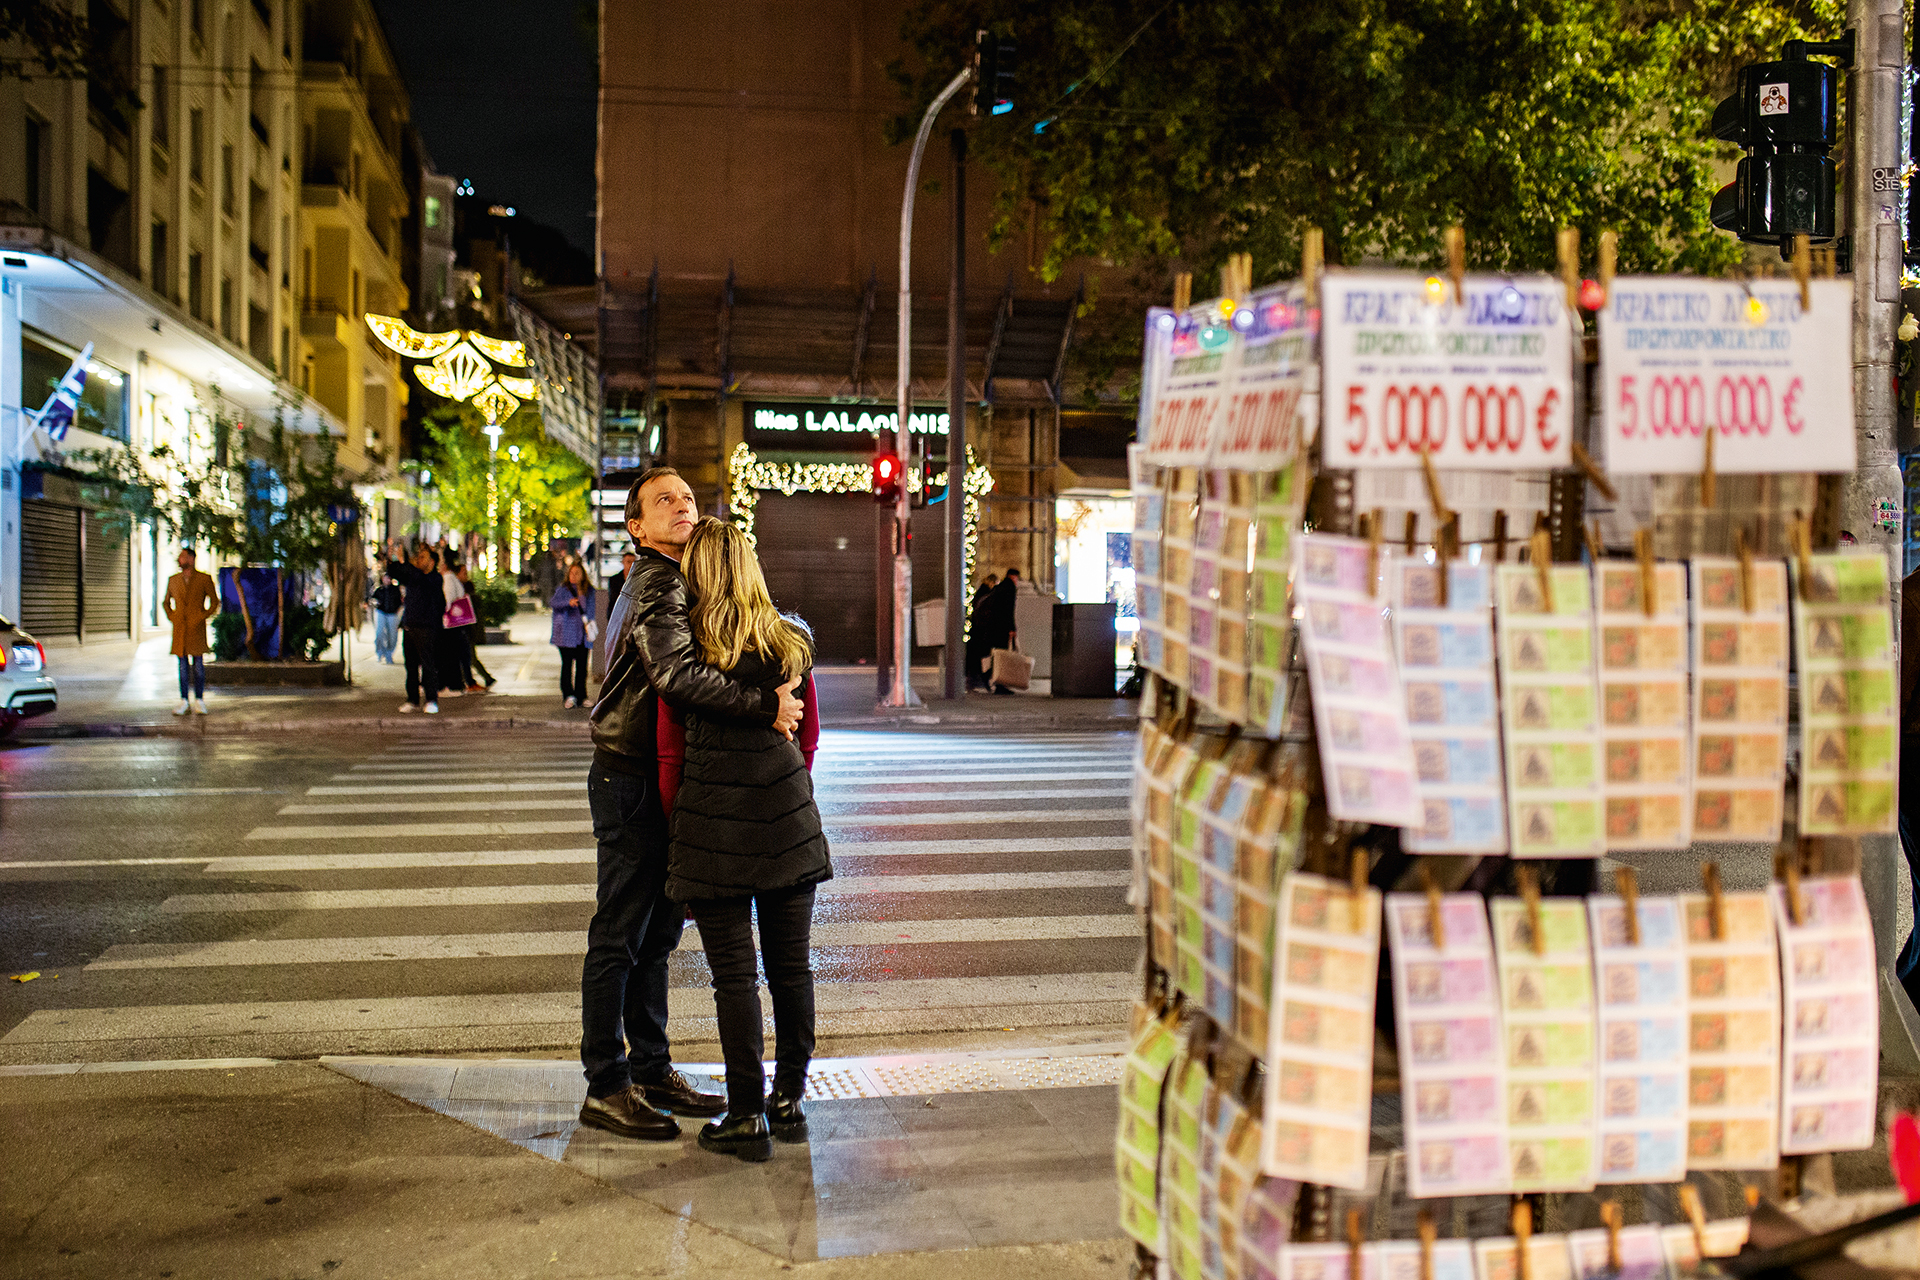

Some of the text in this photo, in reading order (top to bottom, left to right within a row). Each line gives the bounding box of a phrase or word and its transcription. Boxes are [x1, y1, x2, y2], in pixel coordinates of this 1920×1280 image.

[1465, 290, 1560, 325] ΛΑΙΟ
[1722, 292, 1804, 323] ΛΑΕΙΟ
[1536, 385, 1560, 455] €
[1782, 376, 1804, 437] €
